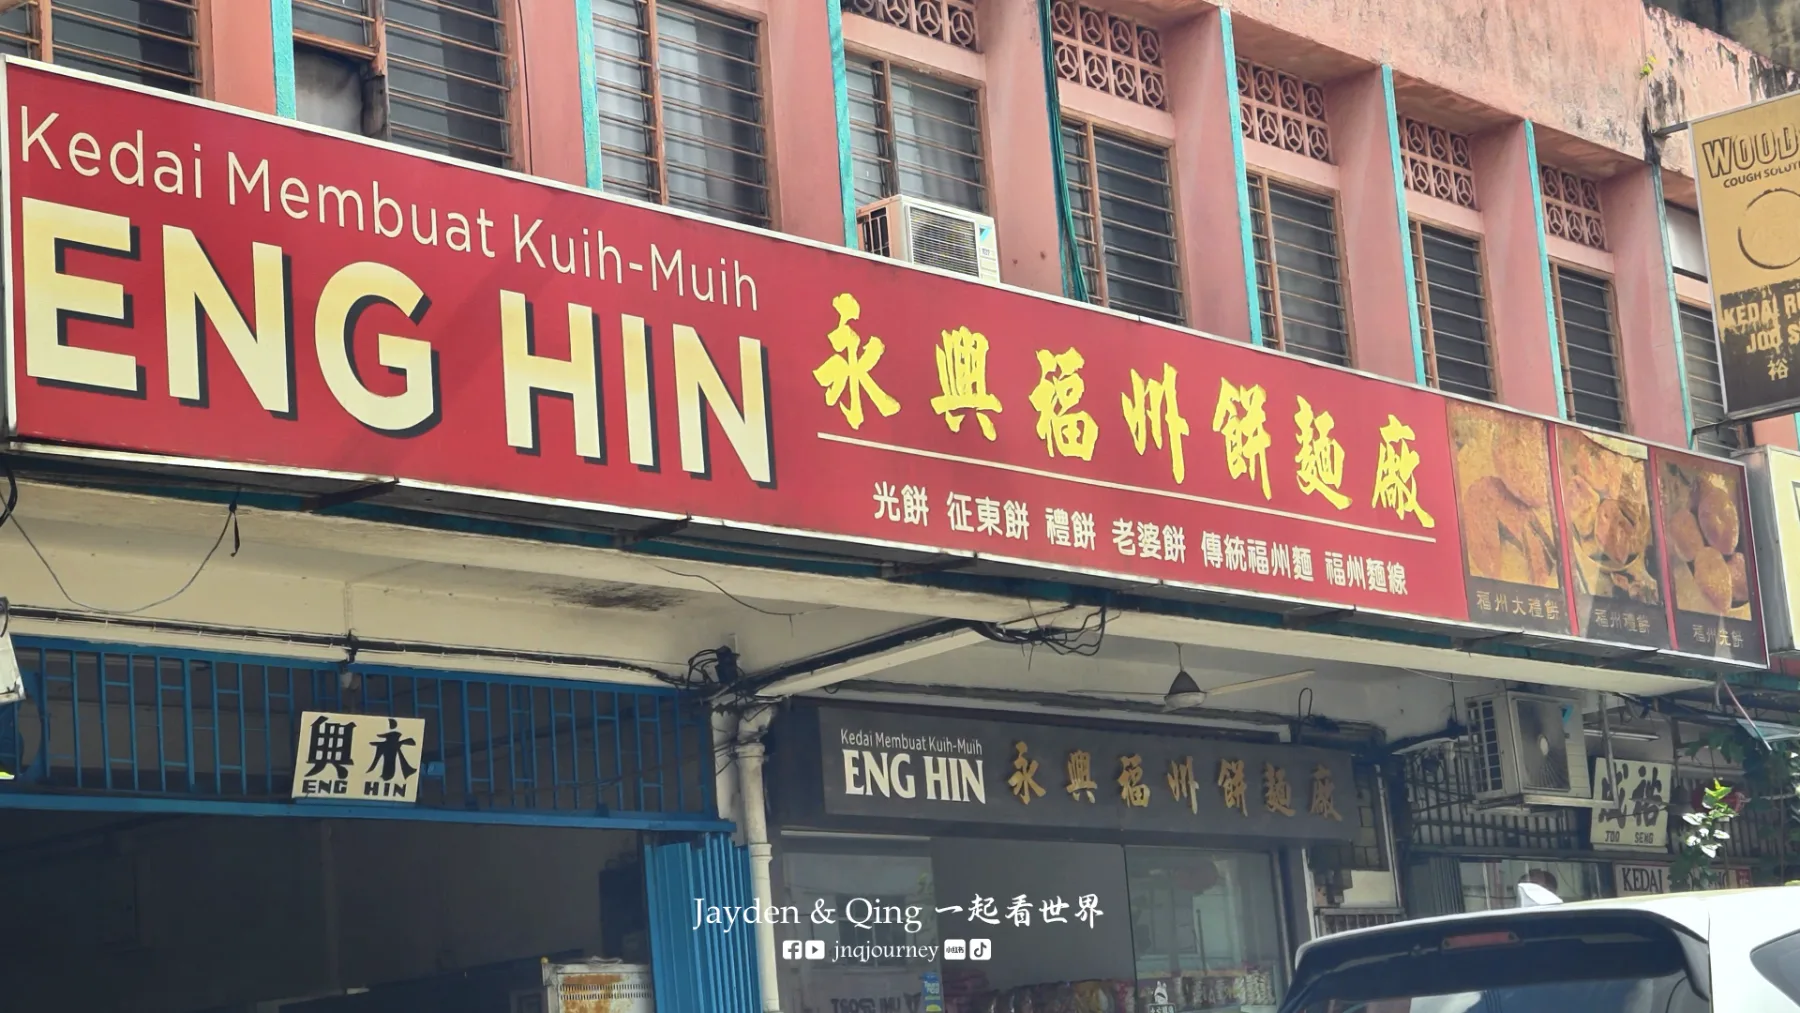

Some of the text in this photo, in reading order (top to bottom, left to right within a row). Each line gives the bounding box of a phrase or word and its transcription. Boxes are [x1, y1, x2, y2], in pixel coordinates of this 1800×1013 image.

[1702, 123, 1800, 178] WOOD
[1723, 171, 1762, 188] COUGH
[21, 105, 759, 311] Kedai Membuat Kuih-Muih
[22, 197, 776, 486] ENG HIN
[1788, 322, 1800, 346] S
[813, 293, 1435, 527] 永興福州餅麵廠
[873, 481, 1408, 595] 光餅 征東餅 禮餅 老婆餅 傳統福州麵 福州麵線
[841, 729, 983, 755] Kedai Membuat Kuih-Muih
[302, 780, 407, 797] ENG HIN
[842, 749, 986, 804] ENG HIN
[1622, 867, 1664, 893] KEDAI
